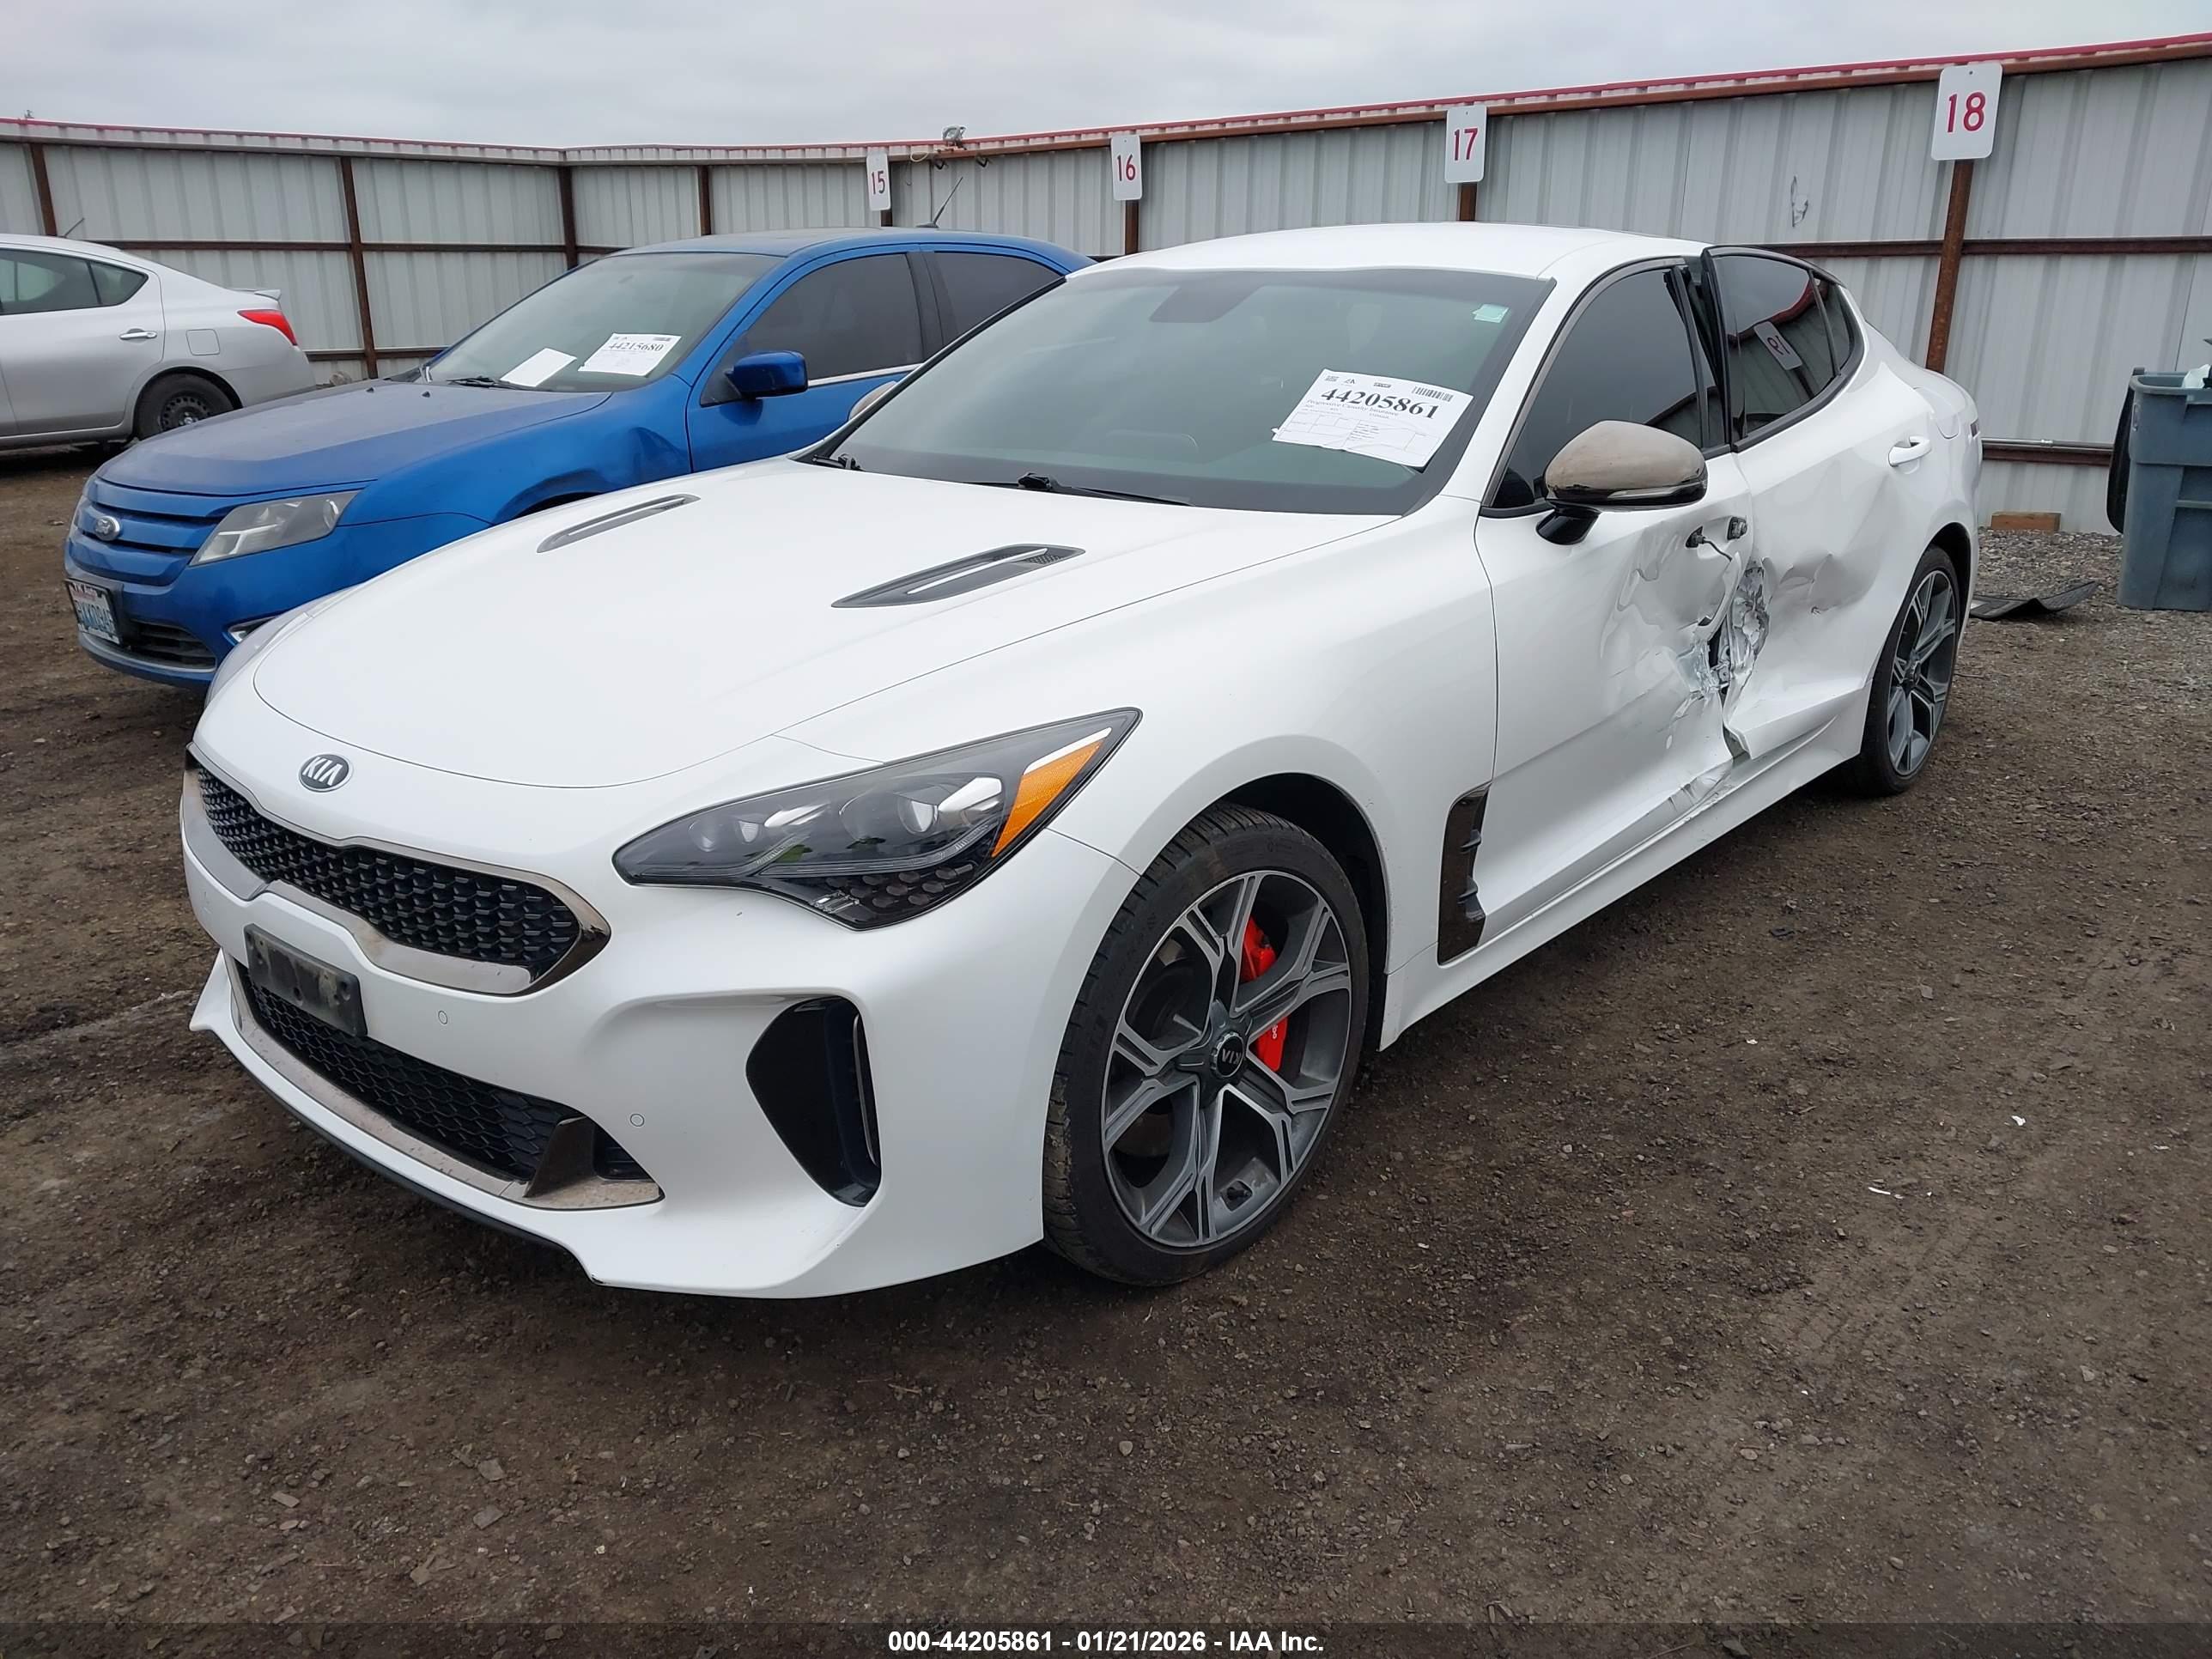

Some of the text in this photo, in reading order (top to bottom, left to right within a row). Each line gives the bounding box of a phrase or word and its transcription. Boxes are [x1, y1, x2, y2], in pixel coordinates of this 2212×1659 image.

[1947, 92, 1986, 133] 18
[1454, 127, 1479, 161] 17
[871, 170, 886, 195] 15
[1116, 154, 1136, 182] 16
[1321, 388, 1440, 420] 44205861
[301, 756, 343, 787] KIA
[1222, 1048, 1242, 1065] KIA
